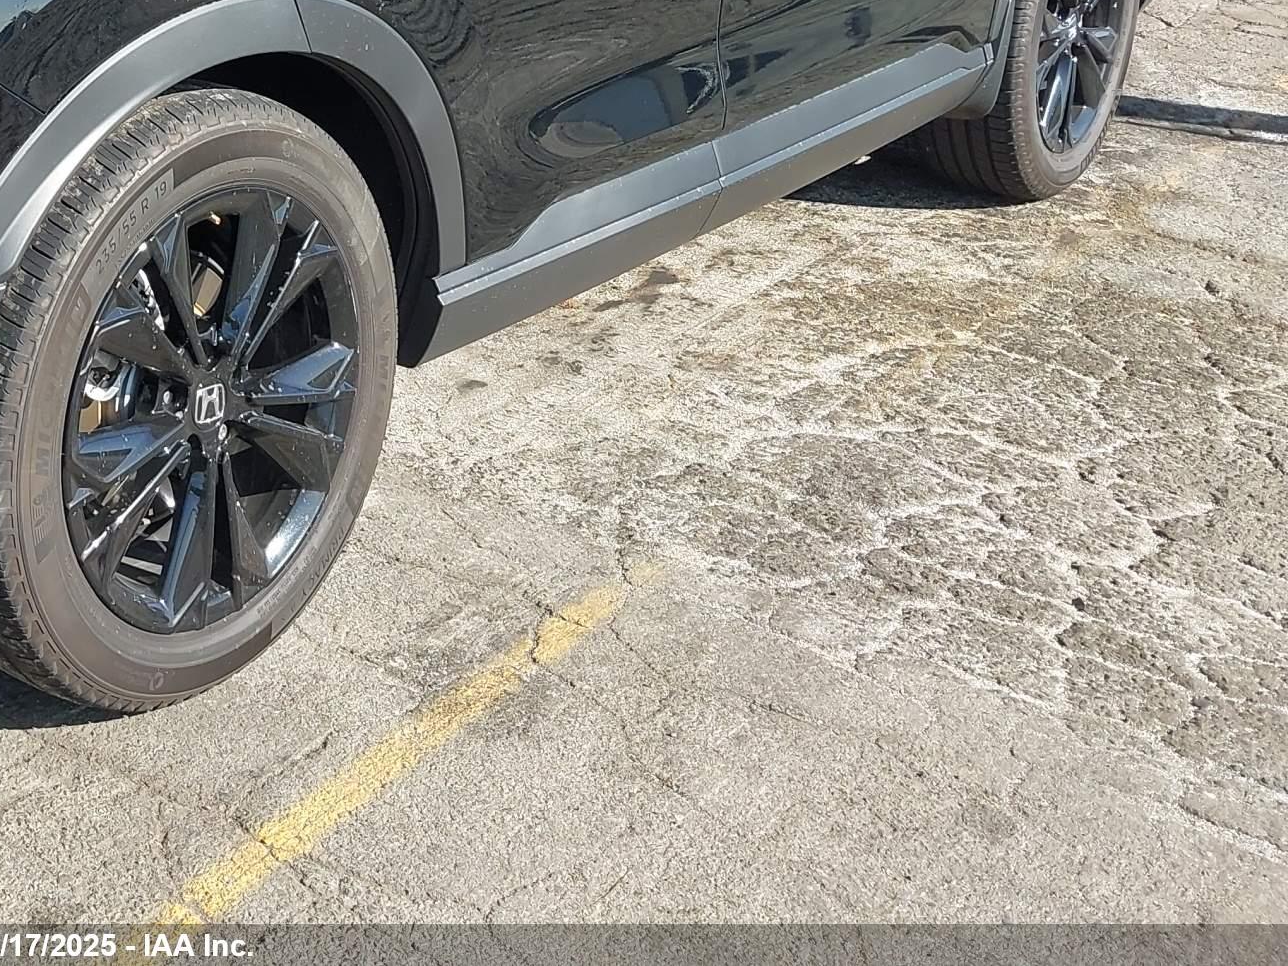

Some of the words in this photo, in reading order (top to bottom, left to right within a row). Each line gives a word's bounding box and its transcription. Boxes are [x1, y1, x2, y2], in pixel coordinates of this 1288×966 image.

[95, 209, 137, 275] 235/55
[140, 197, 149, 214] R
[154, 180, 167, 200] 19
